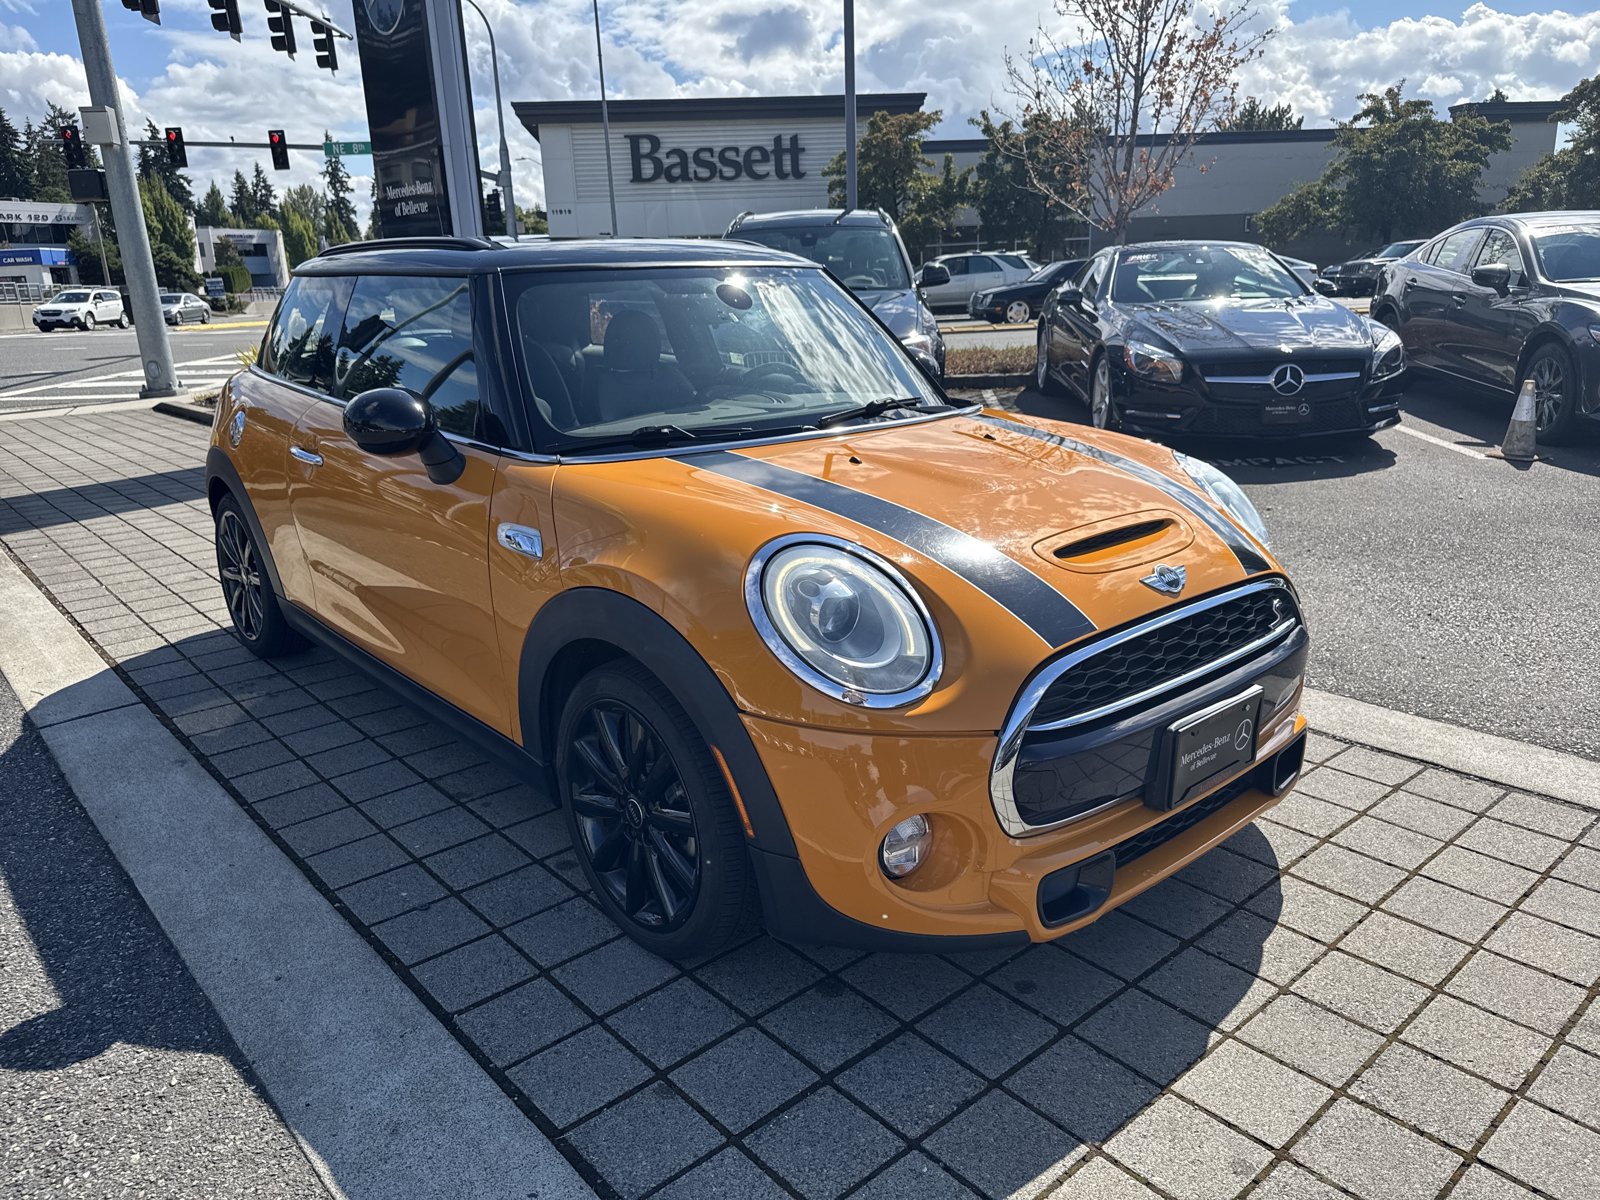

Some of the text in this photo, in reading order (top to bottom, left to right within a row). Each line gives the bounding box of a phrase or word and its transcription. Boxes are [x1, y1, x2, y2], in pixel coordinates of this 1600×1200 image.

[332, 143, 366, 155] NE 8th
[623, 133, 807, 184] Bassett
[387, 180, 433, 200] Mercedes-Benz
[395, 201, 429, 217] of Bellevue
[27, 214, 49, 222] 120
[1207, 455, 1346, 467] MPACT
[1161, 572, 1177, 583] MINI
[1180, 733, 1231, 768] Mercedes-Benz
[1189, 753, 1217, 772] of Bellevue
